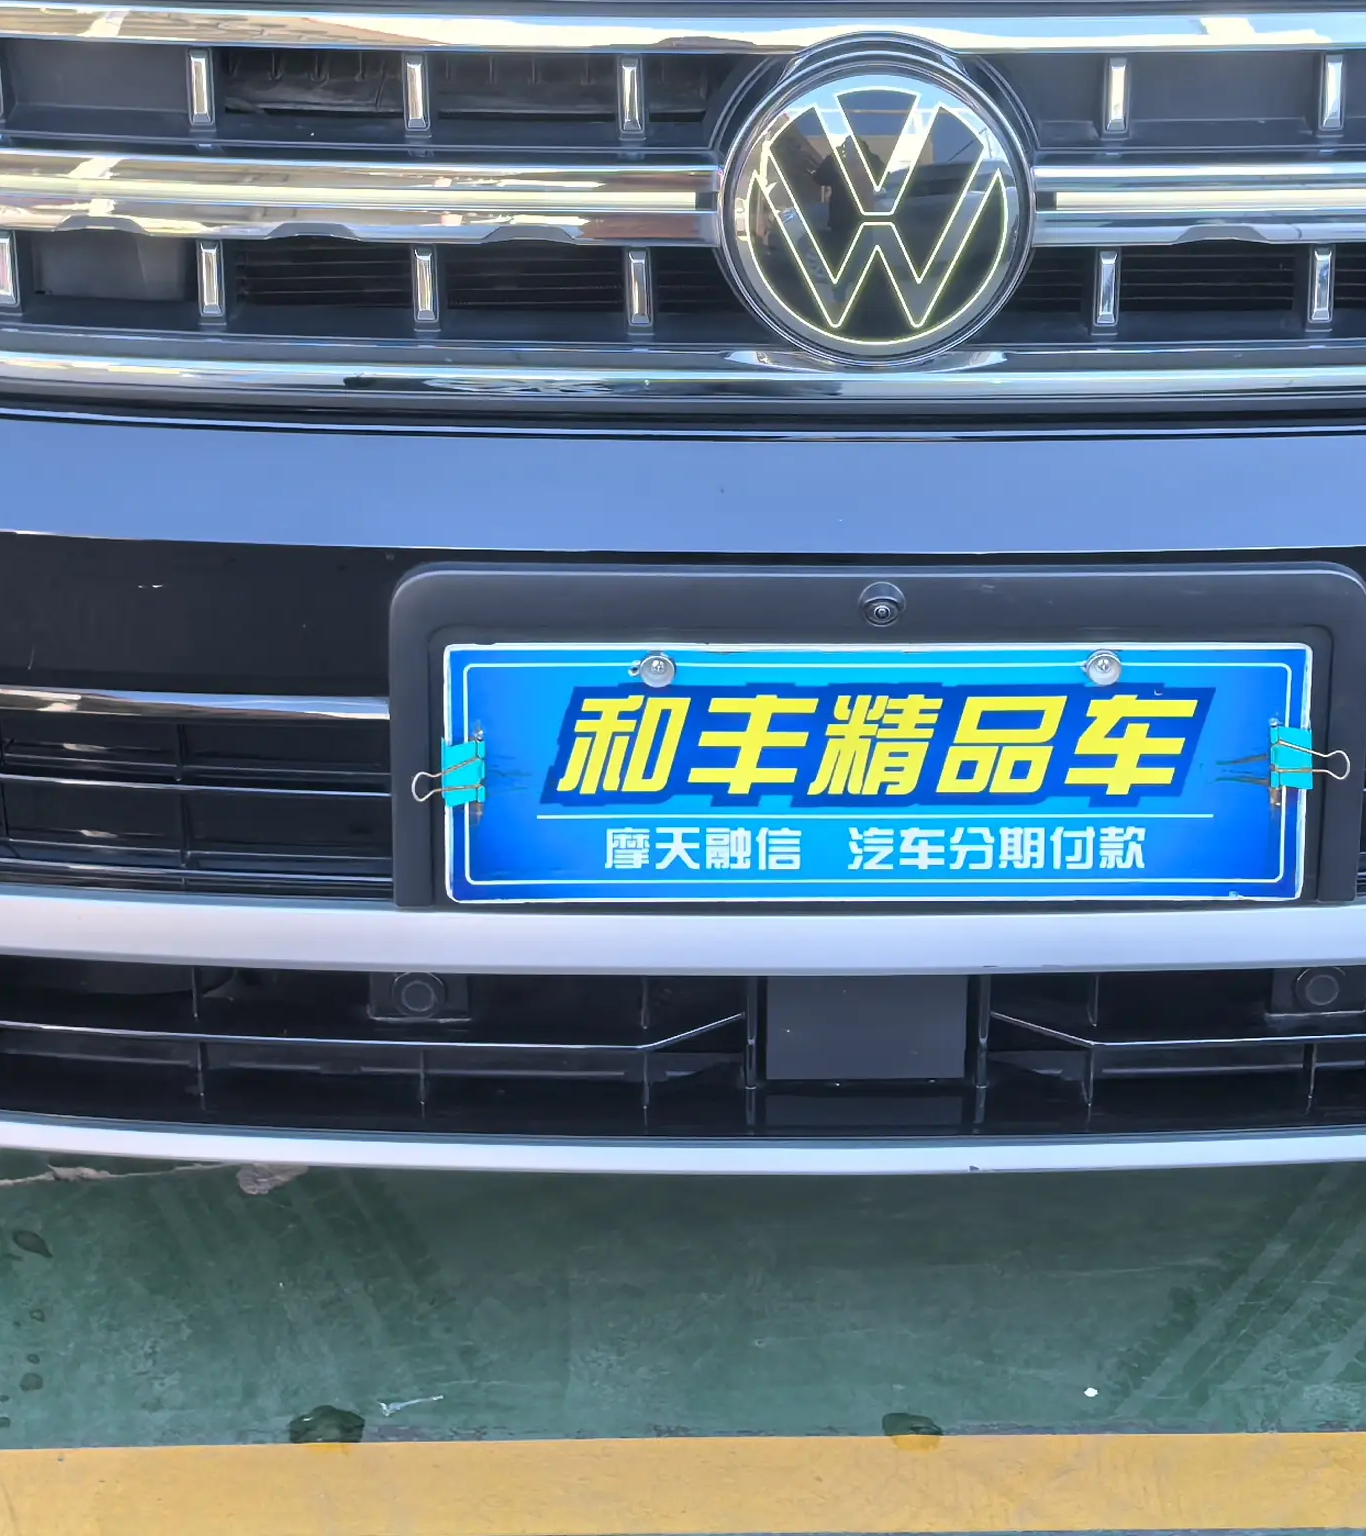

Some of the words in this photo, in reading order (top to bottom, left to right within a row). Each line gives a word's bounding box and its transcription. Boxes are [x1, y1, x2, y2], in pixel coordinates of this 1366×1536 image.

[556, 693, 1198, 796] 和丰精品车
[604, 826, 802, 871] 摩天融信
[847, 826, 1147, 871] 汽车分期付款
